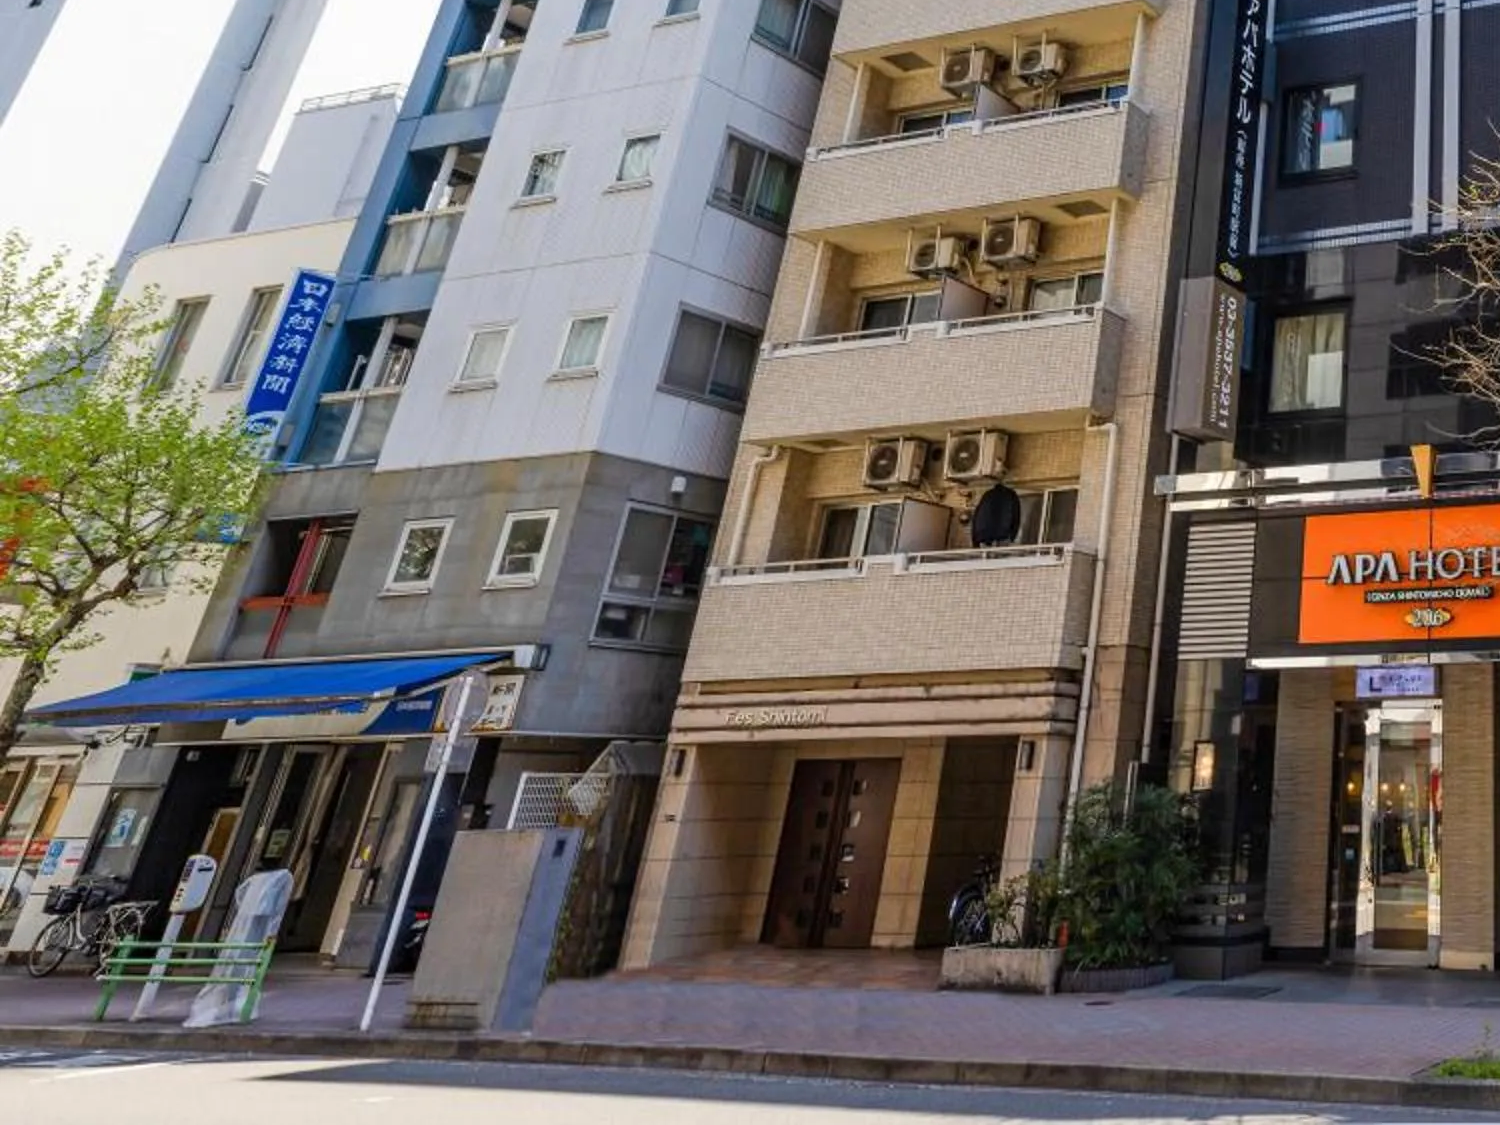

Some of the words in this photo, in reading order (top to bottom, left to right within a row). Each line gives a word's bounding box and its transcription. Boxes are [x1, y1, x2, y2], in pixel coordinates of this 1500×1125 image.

[261, 279, 328, 395] 日本経済新聞
[1327, 551, 1399, 585] APA
